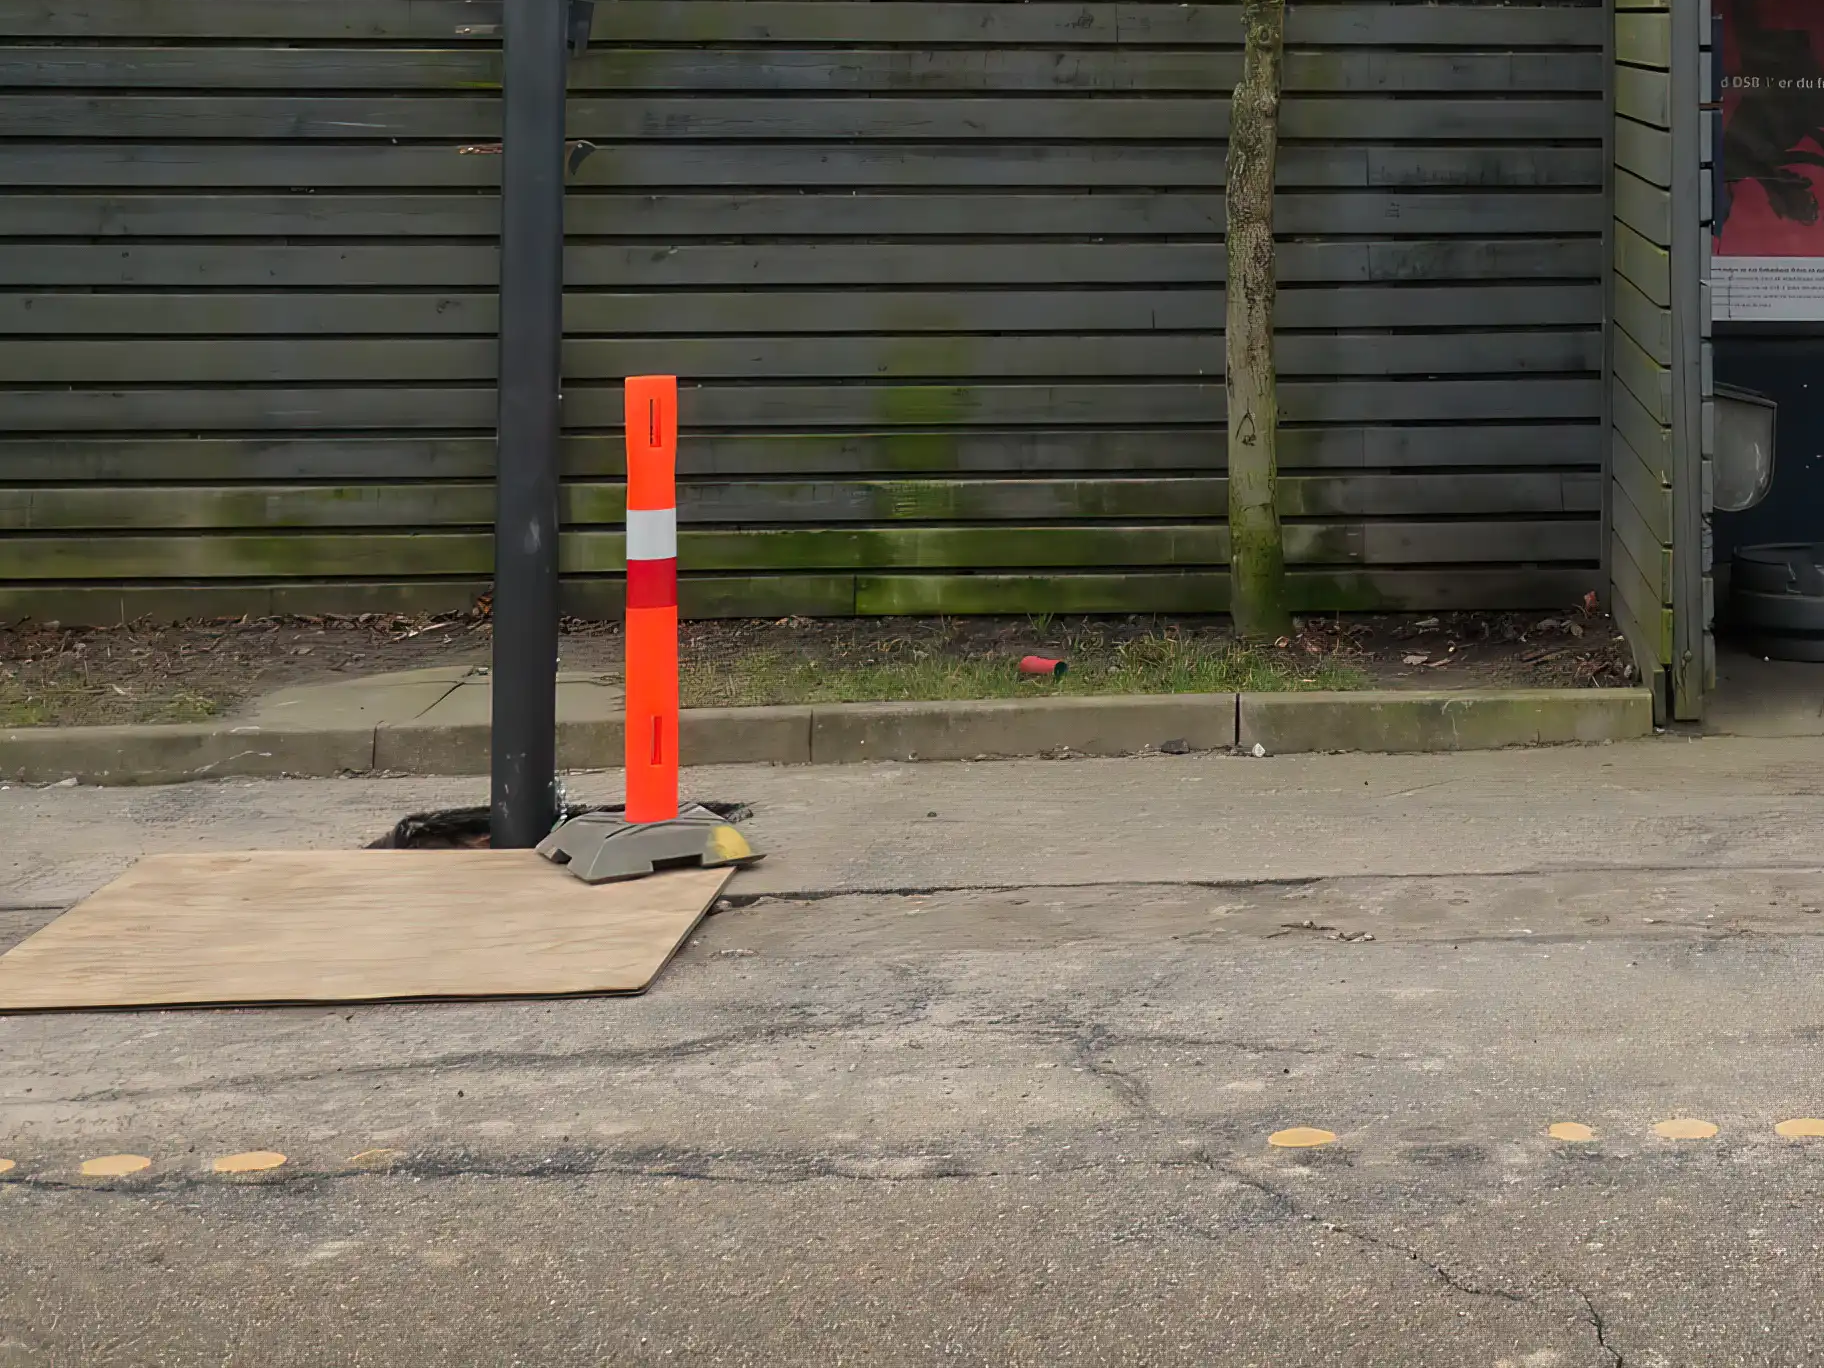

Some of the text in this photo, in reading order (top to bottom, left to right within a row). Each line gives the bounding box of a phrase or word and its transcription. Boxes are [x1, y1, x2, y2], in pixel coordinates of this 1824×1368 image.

[1732, 76, 1760, 89] DSB
[1779, 79, 1793, 89] er
[1797, 77, 1813, 90] du
